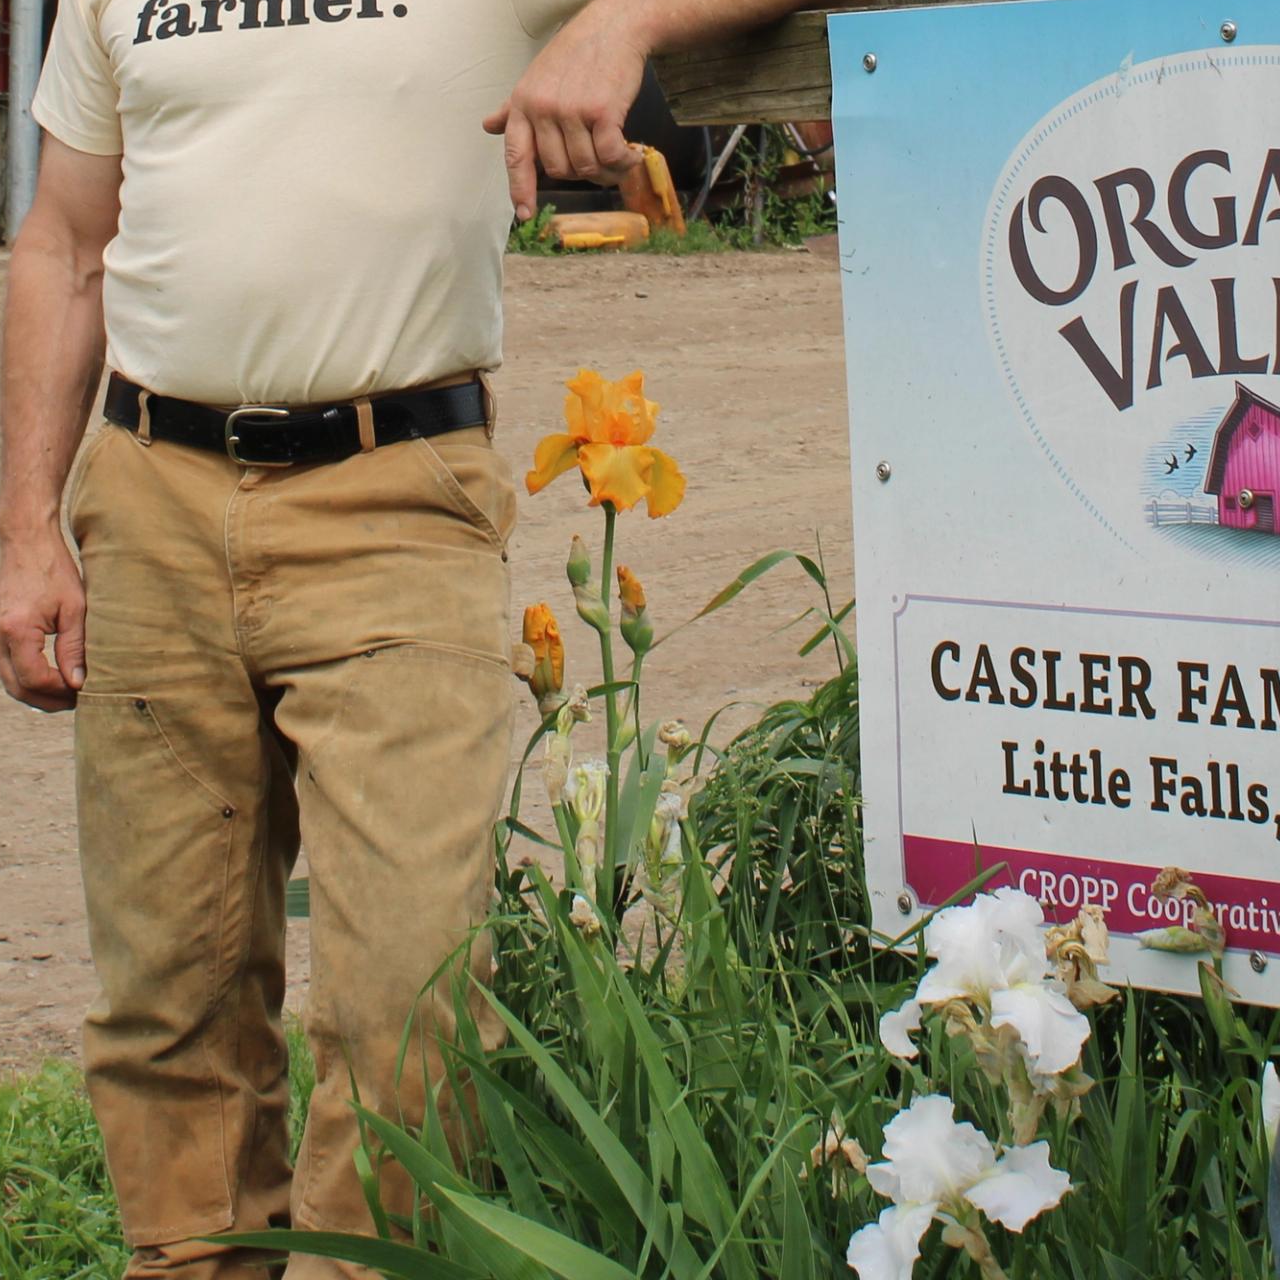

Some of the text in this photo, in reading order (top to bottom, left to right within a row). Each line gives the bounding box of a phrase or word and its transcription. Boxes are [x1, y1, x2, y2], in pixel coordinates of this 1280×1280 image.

[930, 640, 1156, 719] CASLER
[1001, 739, 1131, 808] Little
[1019, 868, 1118, 912] CROPP
